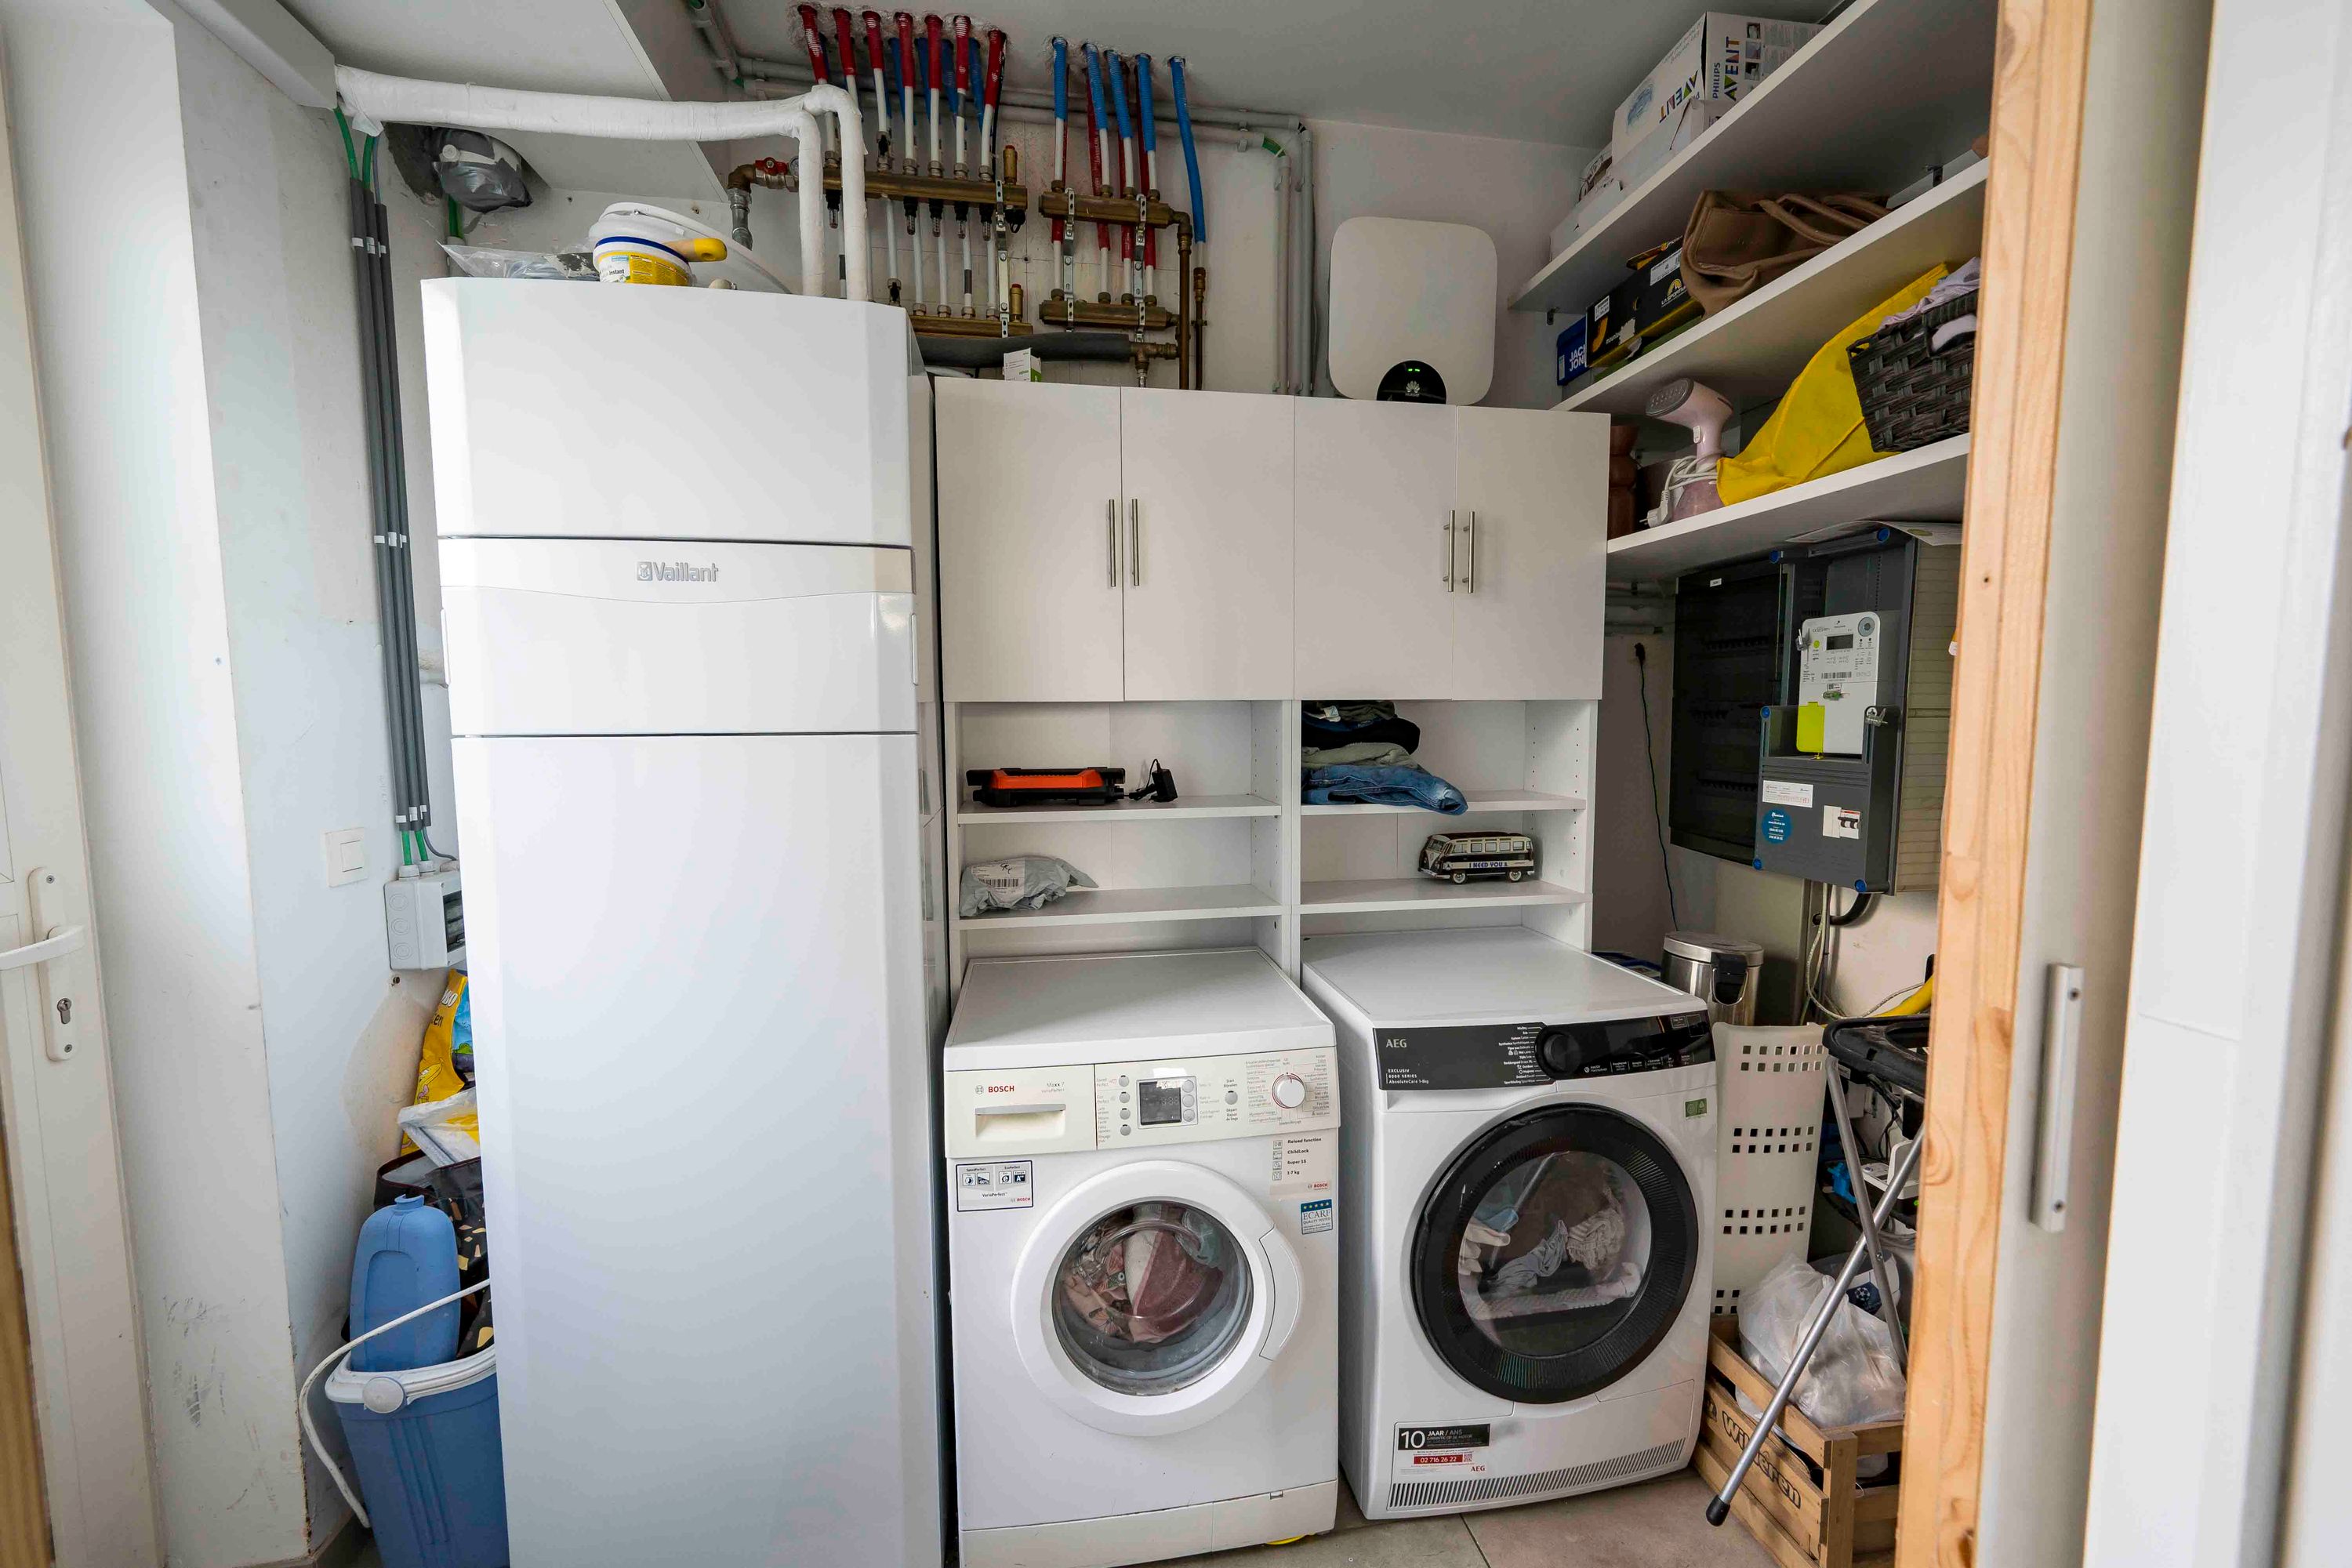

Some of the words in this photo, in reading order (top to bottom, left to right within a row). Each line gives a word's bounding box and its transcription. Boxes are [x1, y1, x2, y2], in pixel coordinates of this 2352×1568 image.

[1724, 36, 1740, 101] AVENT
[1712, 62, 1721, 99] PHILIPS
[653, 561, 719, 582] Vaillant
[1385, 1039, 1407, 1048] AEG
[1303, 1209, 1330, 1220] ECARF
[1401, 1430, 1425, 1449] 10
[1722, 1410, 1802, 1510] Wileren
